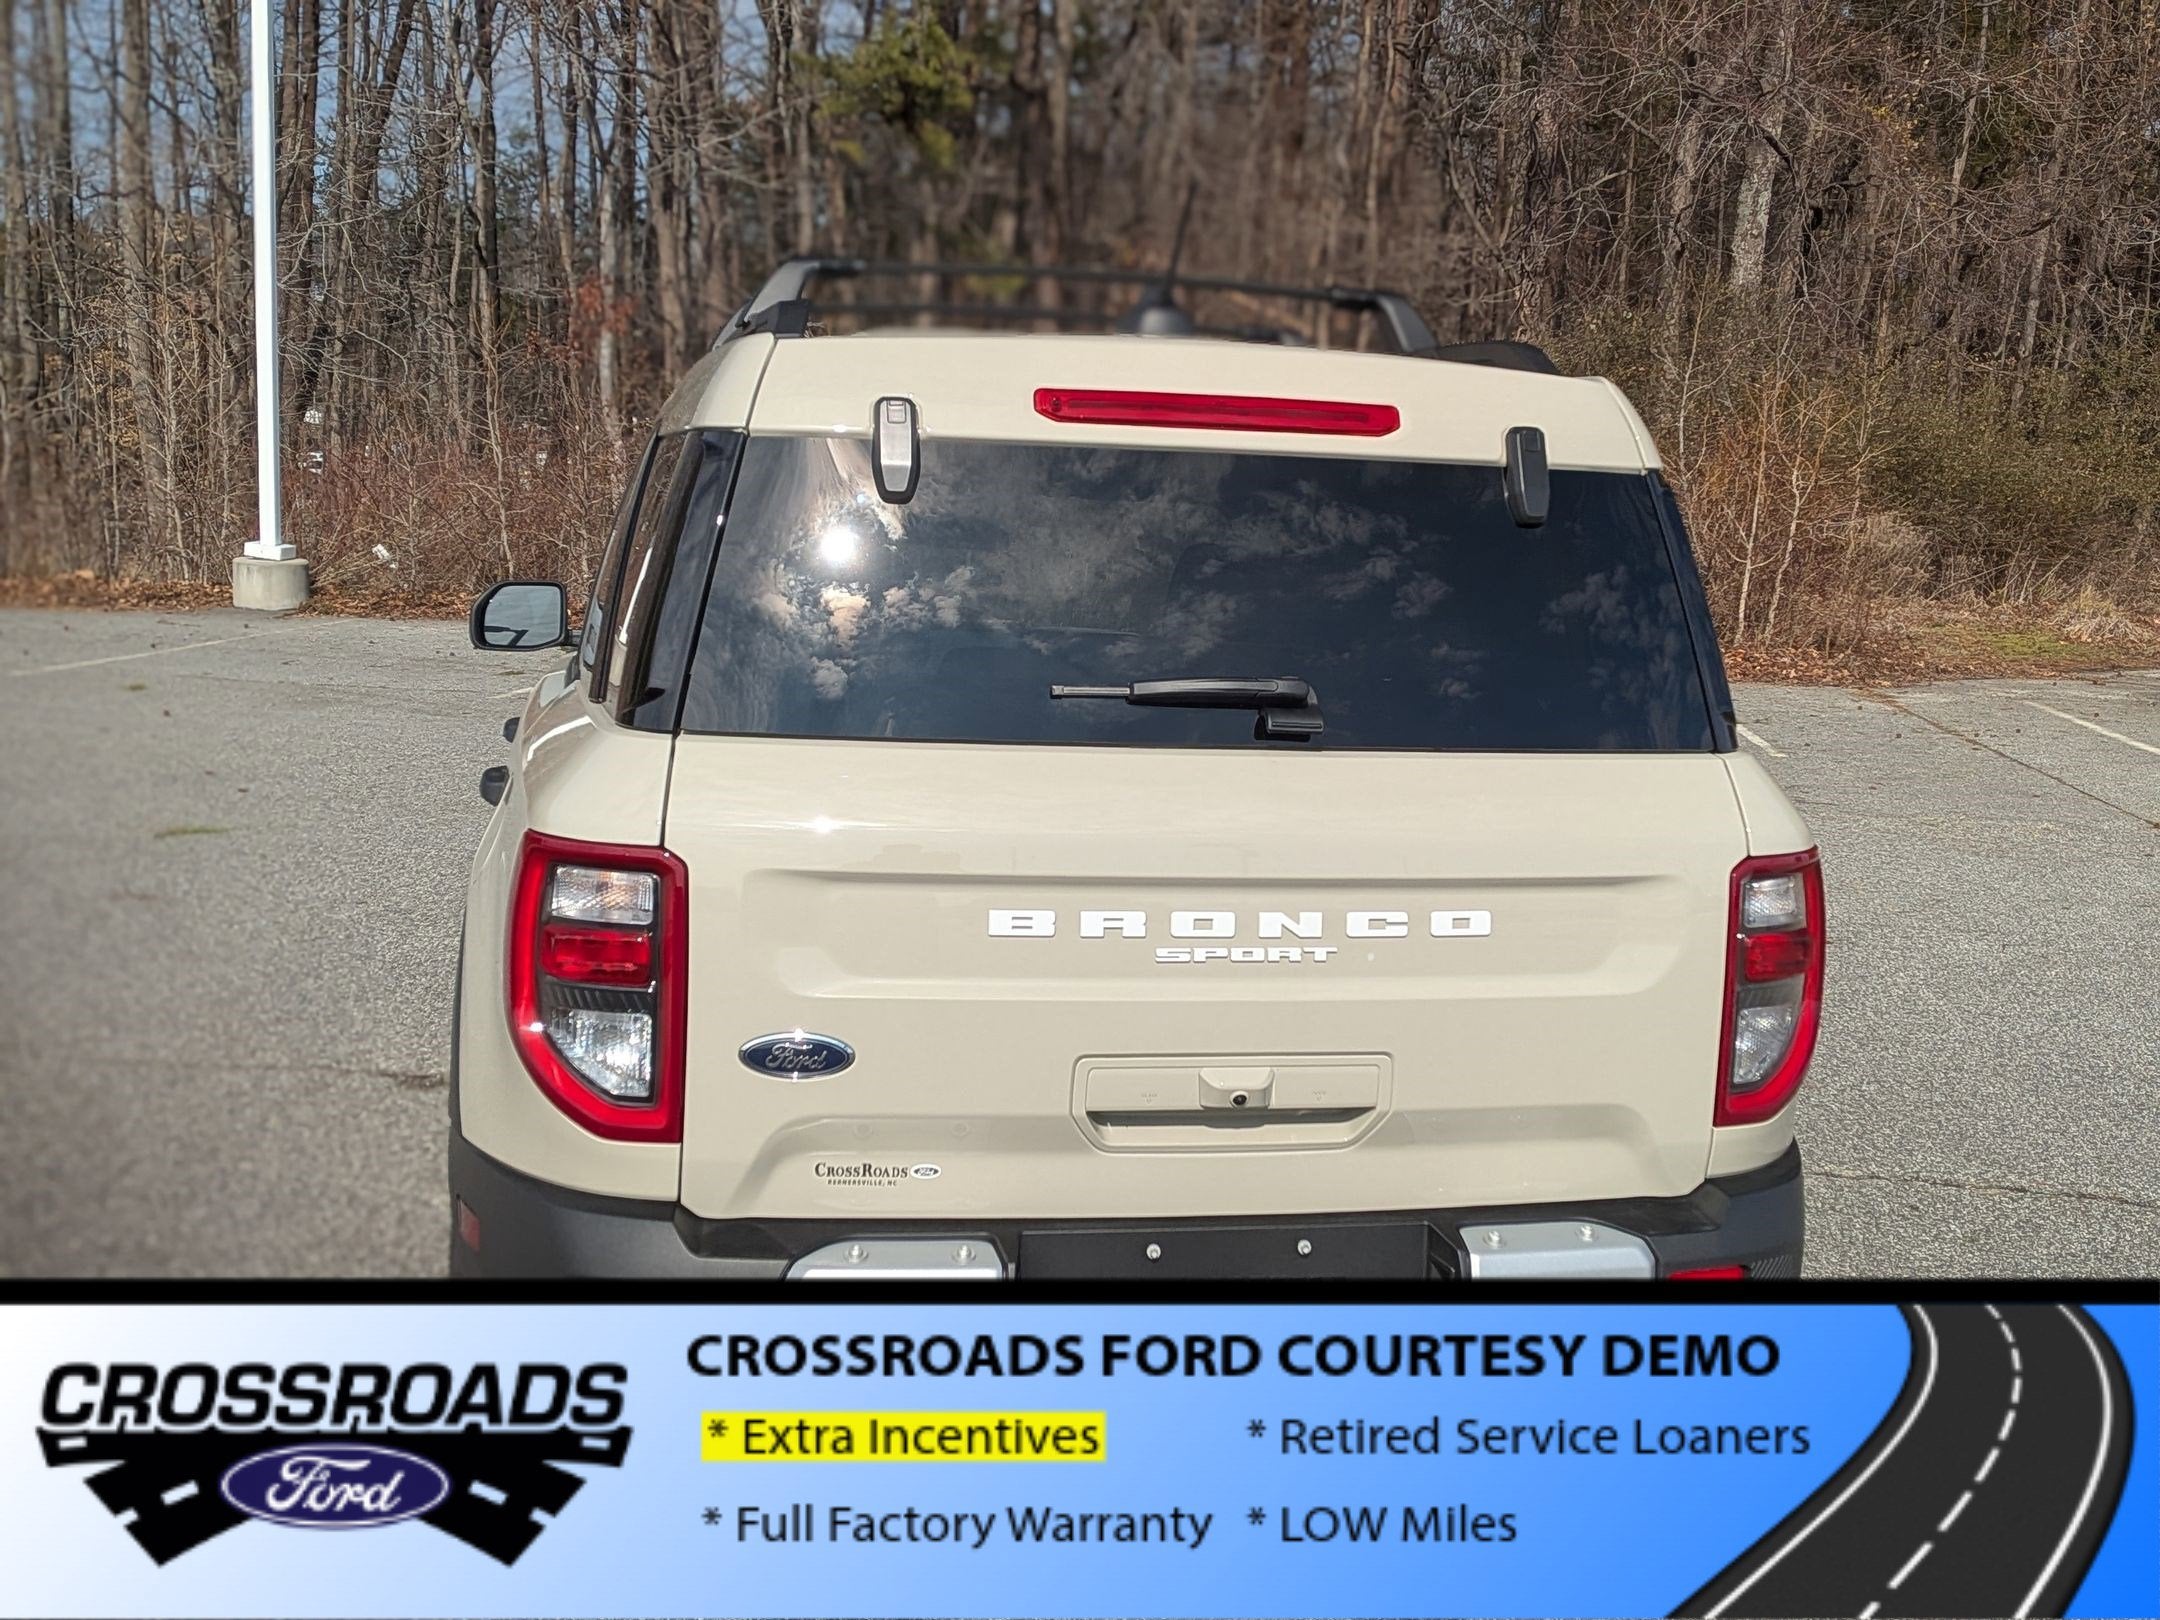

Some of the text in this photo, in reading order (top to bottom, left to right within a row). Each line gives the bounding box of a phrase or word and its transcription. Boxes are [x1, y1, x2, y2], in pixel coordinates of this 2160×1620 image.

[989, 909, 1493, 941] BRONCO
[1154, 946, 1338, 965] SPORT
[765, 1042, 827, 1068] Ford
